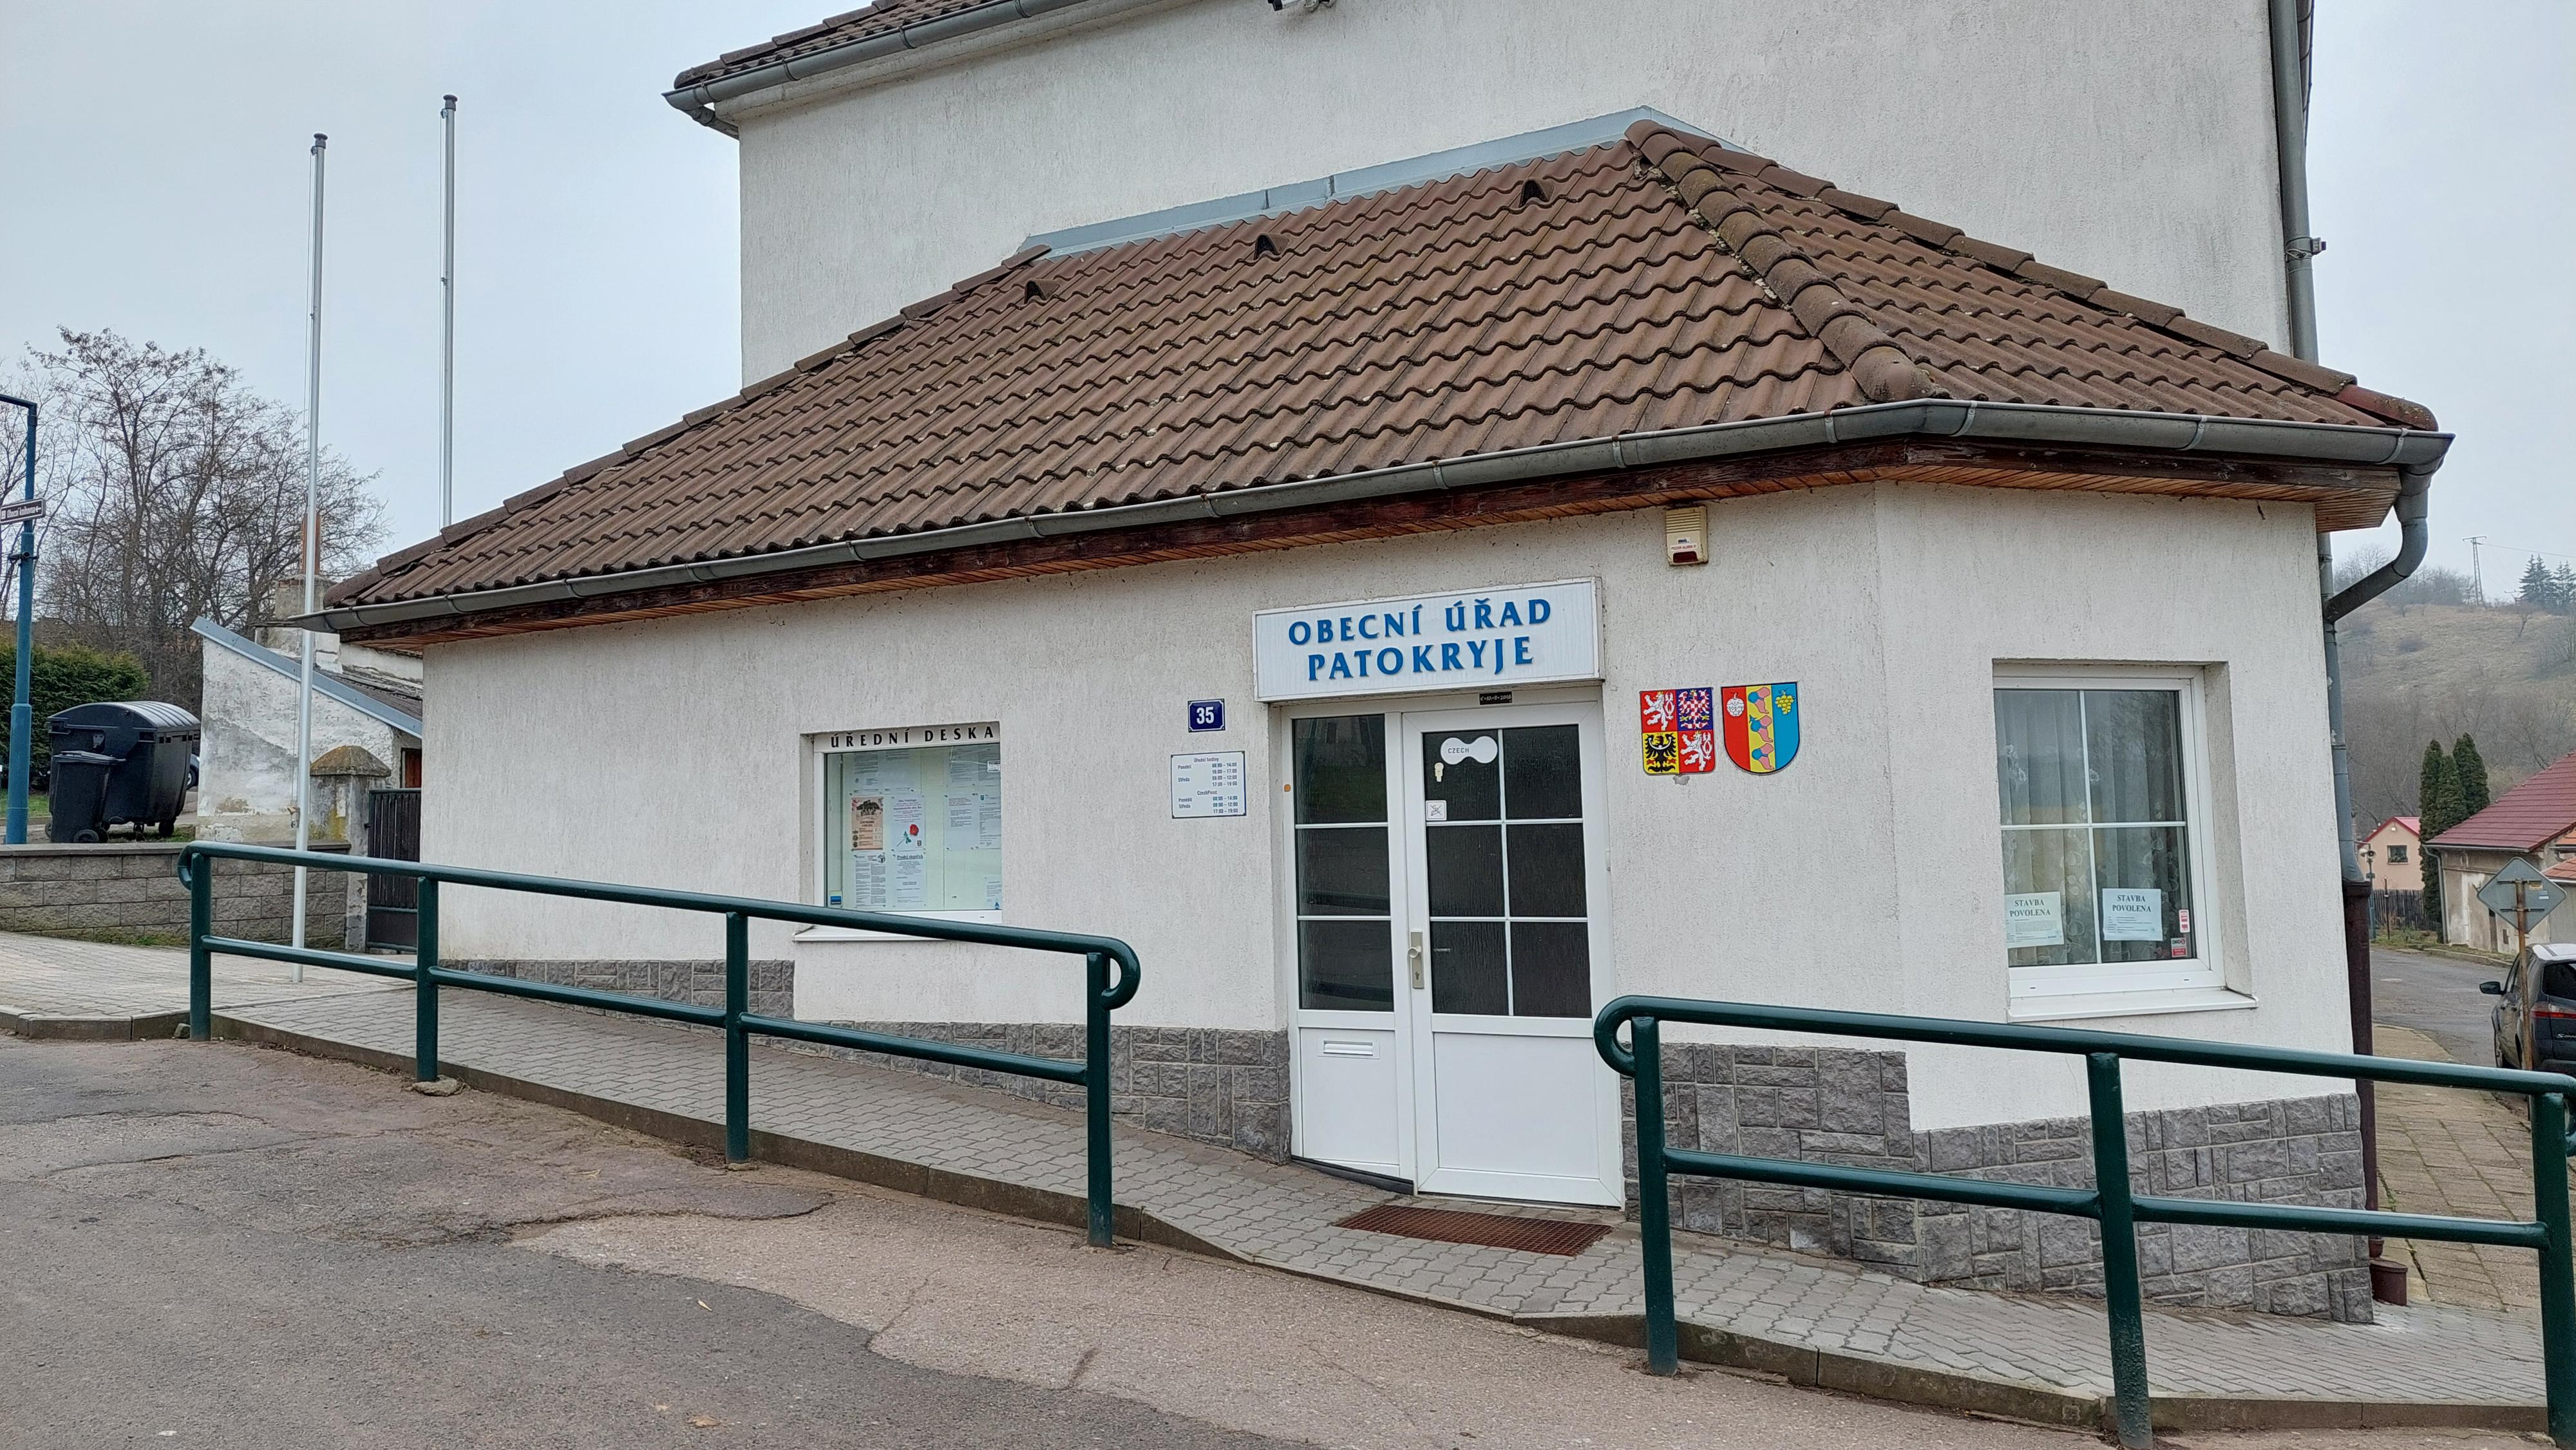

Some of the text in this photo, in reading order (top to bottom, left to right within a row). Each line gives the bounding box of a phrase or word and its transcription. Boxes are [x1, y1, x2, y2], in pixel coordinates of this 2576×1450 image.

[1288, 598, 1551, 645] OBECNÍ ÚŘAD
[1307, 636, 1534, 681] PATOKRYJE
[1196, 706, 1215, 724] 35
[831, 726, 994, 748] ÚŘEDNÍ DESKA
[2014, 899, 2045, 907] STAVBA
[2009, 909, 2051, 918] POVOLENA
